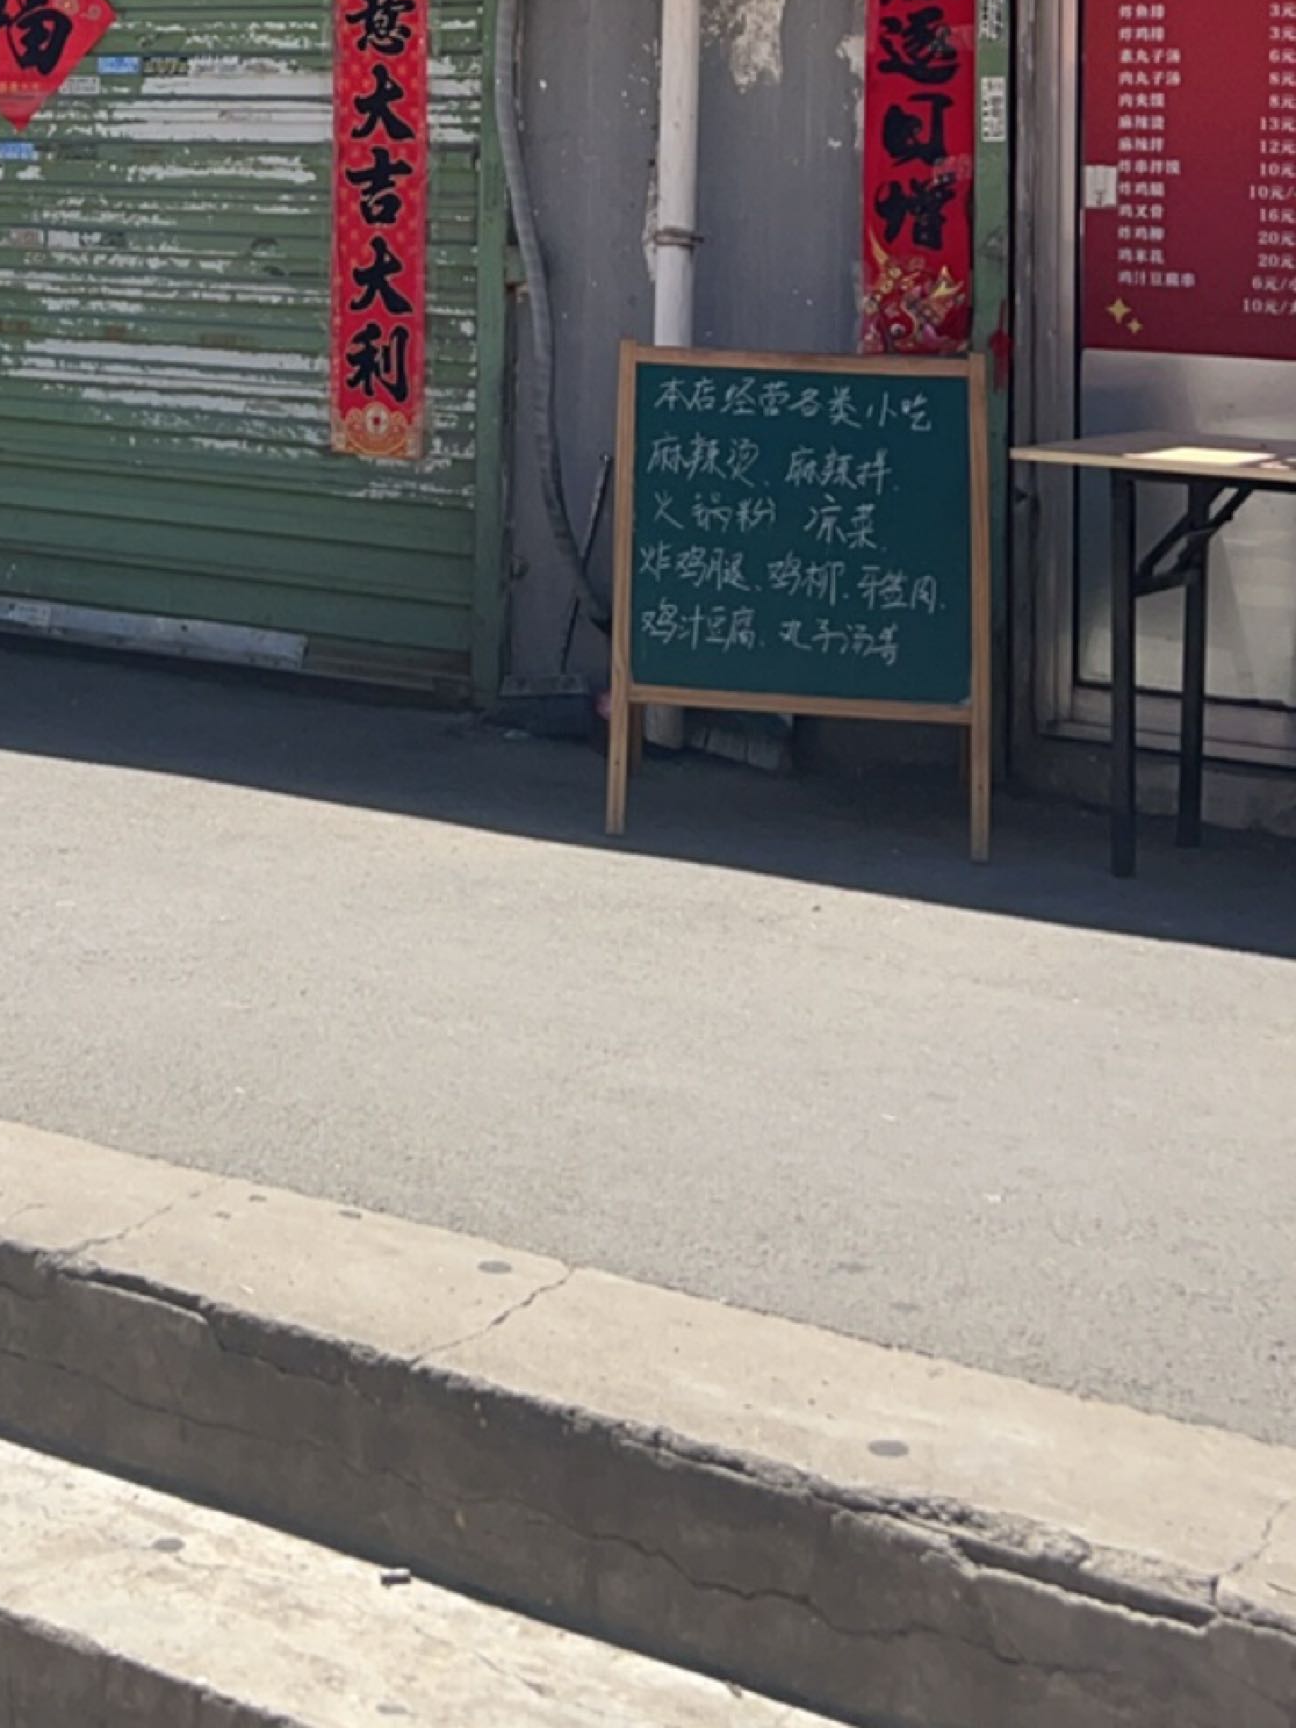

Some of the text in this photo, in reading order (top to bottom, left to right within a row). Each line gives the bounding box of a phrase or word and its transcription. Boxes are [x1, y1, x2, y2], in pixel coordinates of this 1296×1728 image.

[653, 376, 933, 432] 本店经营各类小吃
